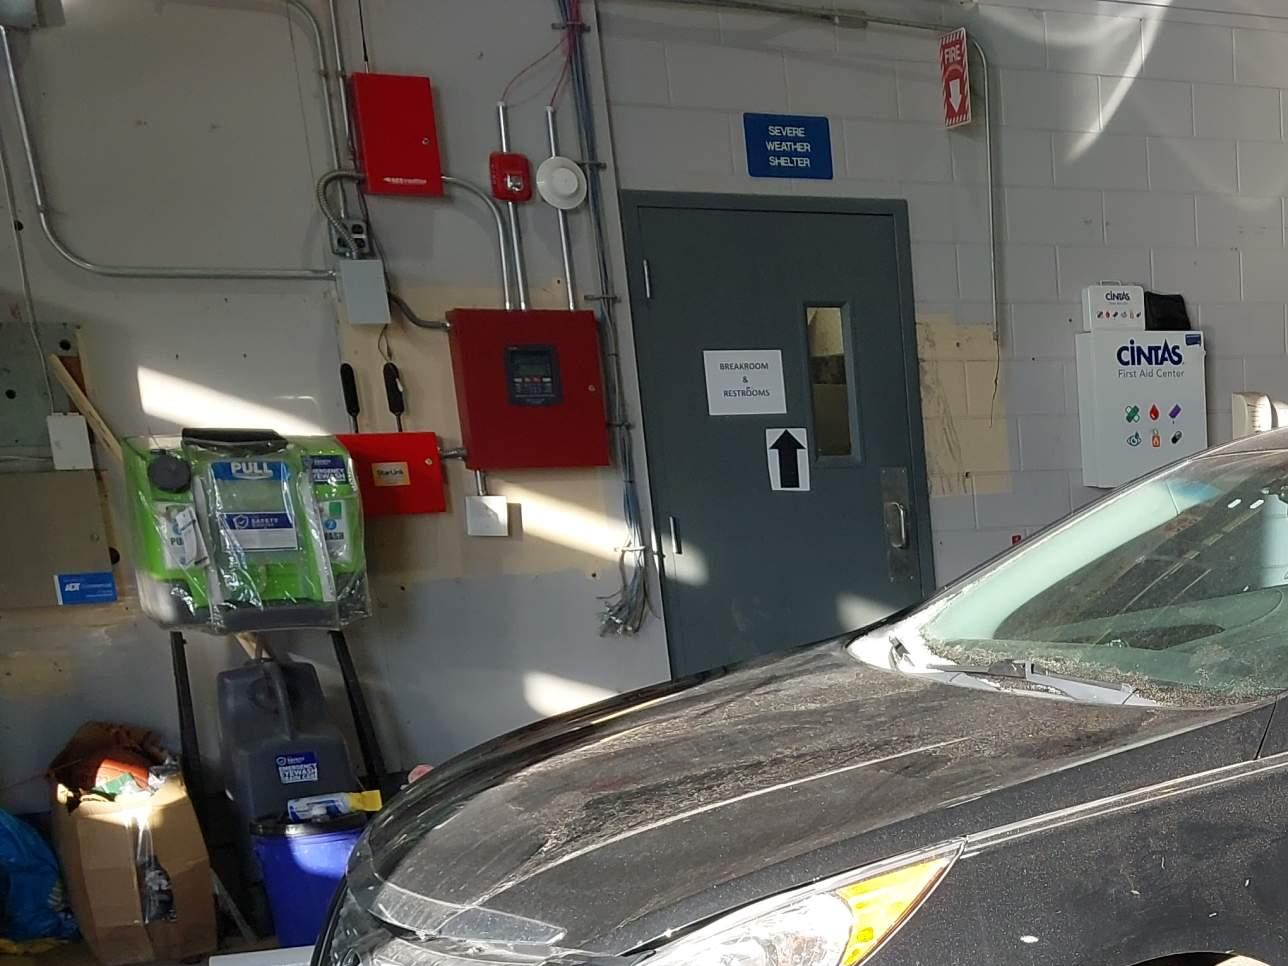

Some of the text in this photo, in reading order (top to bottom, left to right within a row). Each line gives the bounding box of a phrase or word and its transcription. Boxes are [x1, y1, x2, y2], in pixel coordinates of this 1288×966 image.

[944, 44, 961, 64] FIRE
[768, 126, 806, 137] SEVERE
[766, 141, 811, 153] WEATHER
[769, 156, 811, 167] SHELTER
[719, 362, 769, 370] BREAKROOM
[1118, 368, 1185, 378] First Aid Center
[742, 376, 749, 384] &
[723, 389, 770, 397] RESTROOMS
[230, 461, 273, 475] PULL
